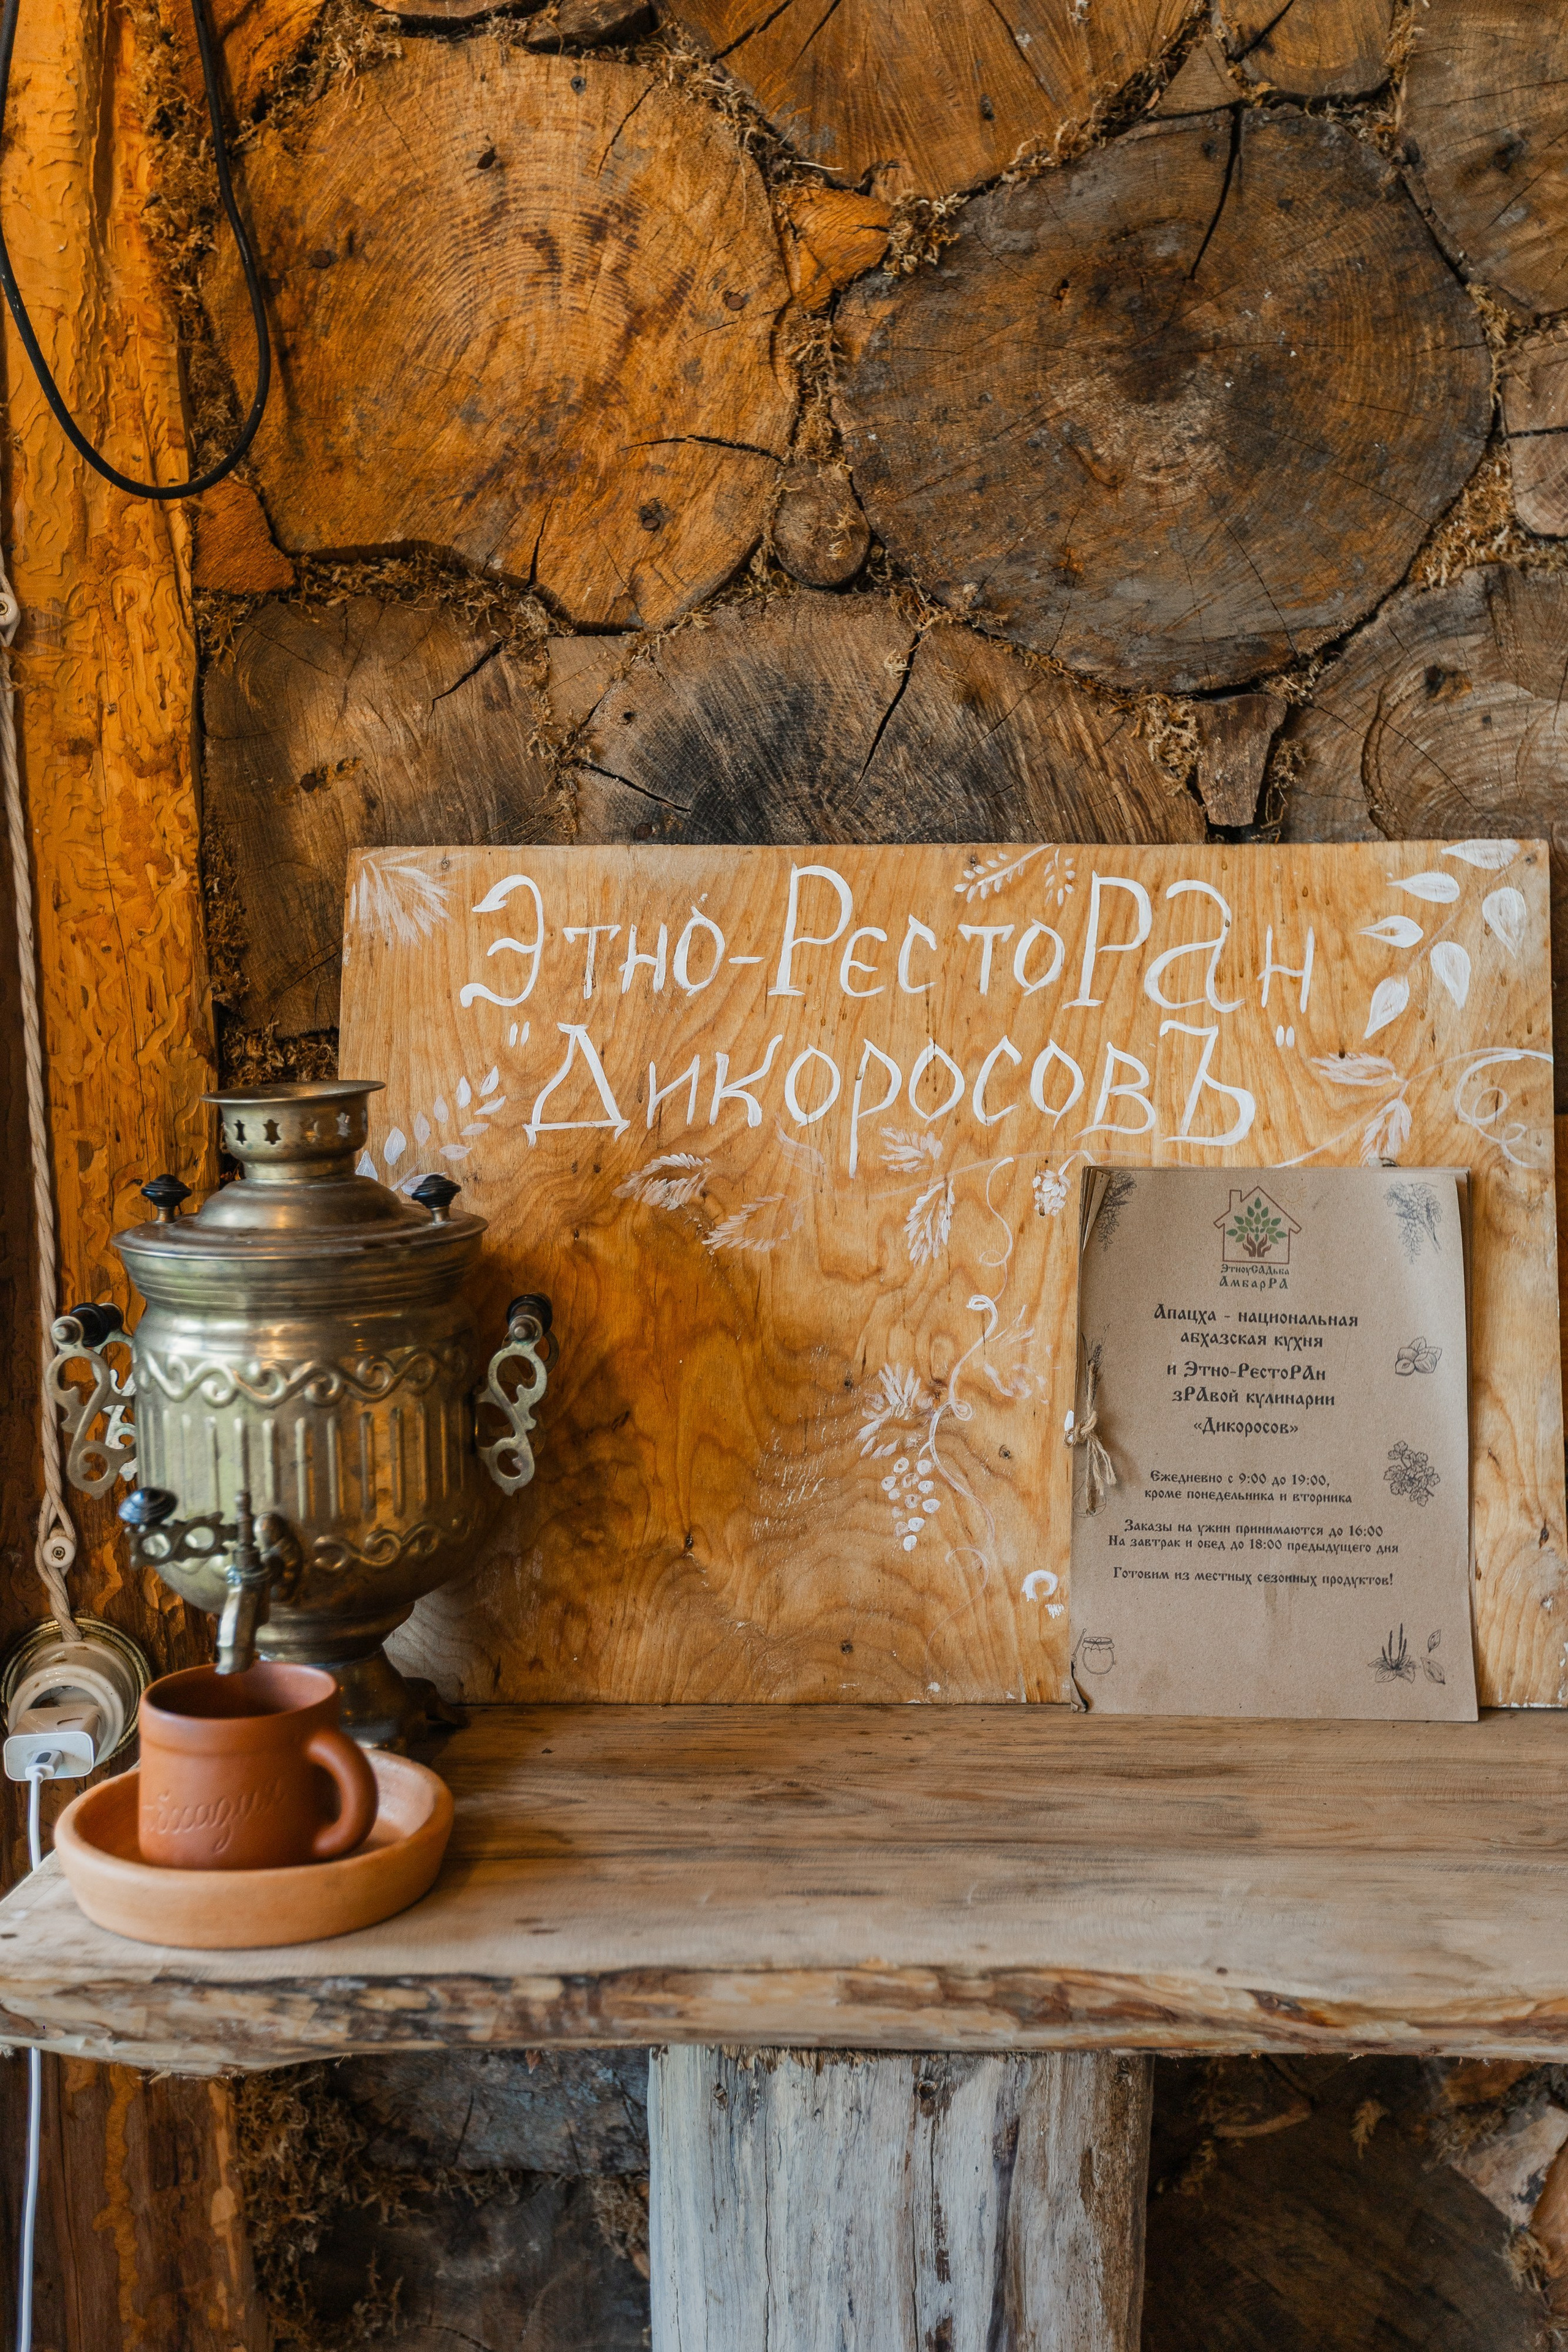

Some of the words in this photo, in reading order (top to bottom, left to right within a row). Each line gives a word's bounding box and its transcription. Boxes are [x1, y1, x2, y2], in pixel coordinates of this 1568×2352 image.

[1219, 1275, 1289, 1292] АмбарРА
[1153, 1303, 1217, 1325] Апацха
[1238, 1311, 1359, 1327] национальная
[1180, 1332, 1267, 1348] абхазская
[1274, 1335, 1323, 1352] кухня
[1167, 1363, 1177, 1376] и
[1183, 1360, 1326, 1381] Этно-РестоРАн
[1172, 1385, 1238, 1403] зРАвой
[1246, 1392, 1335, 1410] кулинарии
[1193, 1416, 1298, 1438] «Дикоросов»
[1150, 1469, 1223, 1485] Ежедневно
[1227, 1475, 1234, 1484] с
[1238, 1472, 1267, 1485] 9:00
[1271, 1476, 1286, 1487] до
[1292, 1474, 1330, 1488] 19:00,
[1145, 1490, 1182, 1502] кроме
[1186, 1490, 1275, 1502] понедельника
[1280, 1493, 1287, 1501] и
[1292, 1493, 1352, 1506] вторника
[1124, 1518, 1172, 1532] Заказы
[1177, 1523, 1193, 1532] на
[1197, 1524, 1231, 1537] ужин
[1235, 1525, 1324, 1537] принимаются
[1328, 1527, 1343, 1539] до
[1349, 1525, 1384, 1537] 16:00
[1108, 1534, 1126, 1547] На
[1130, 1539, 1181, 1551] завтрак
[1185, 1539, 1193, 1548] и
[1197, 1539, 1226, 1550] обед
[1230, 1540, 1245, 1551] до
[1250, 1538, 1283, 1550] 18:00
[1287, 1542, 1371, 1556] предыдущего
[1376, 1545, 1398, 1556] дня
[1113, 1566, 1170, 1580] Готовим
[1174, 1572, 1190, 1581] из
[1194, 1572, 1253, 1586] местных
[1257, 1574, 1317, 1587] сезонных
[1322, 1572, 1393, 1588] продуктов!
